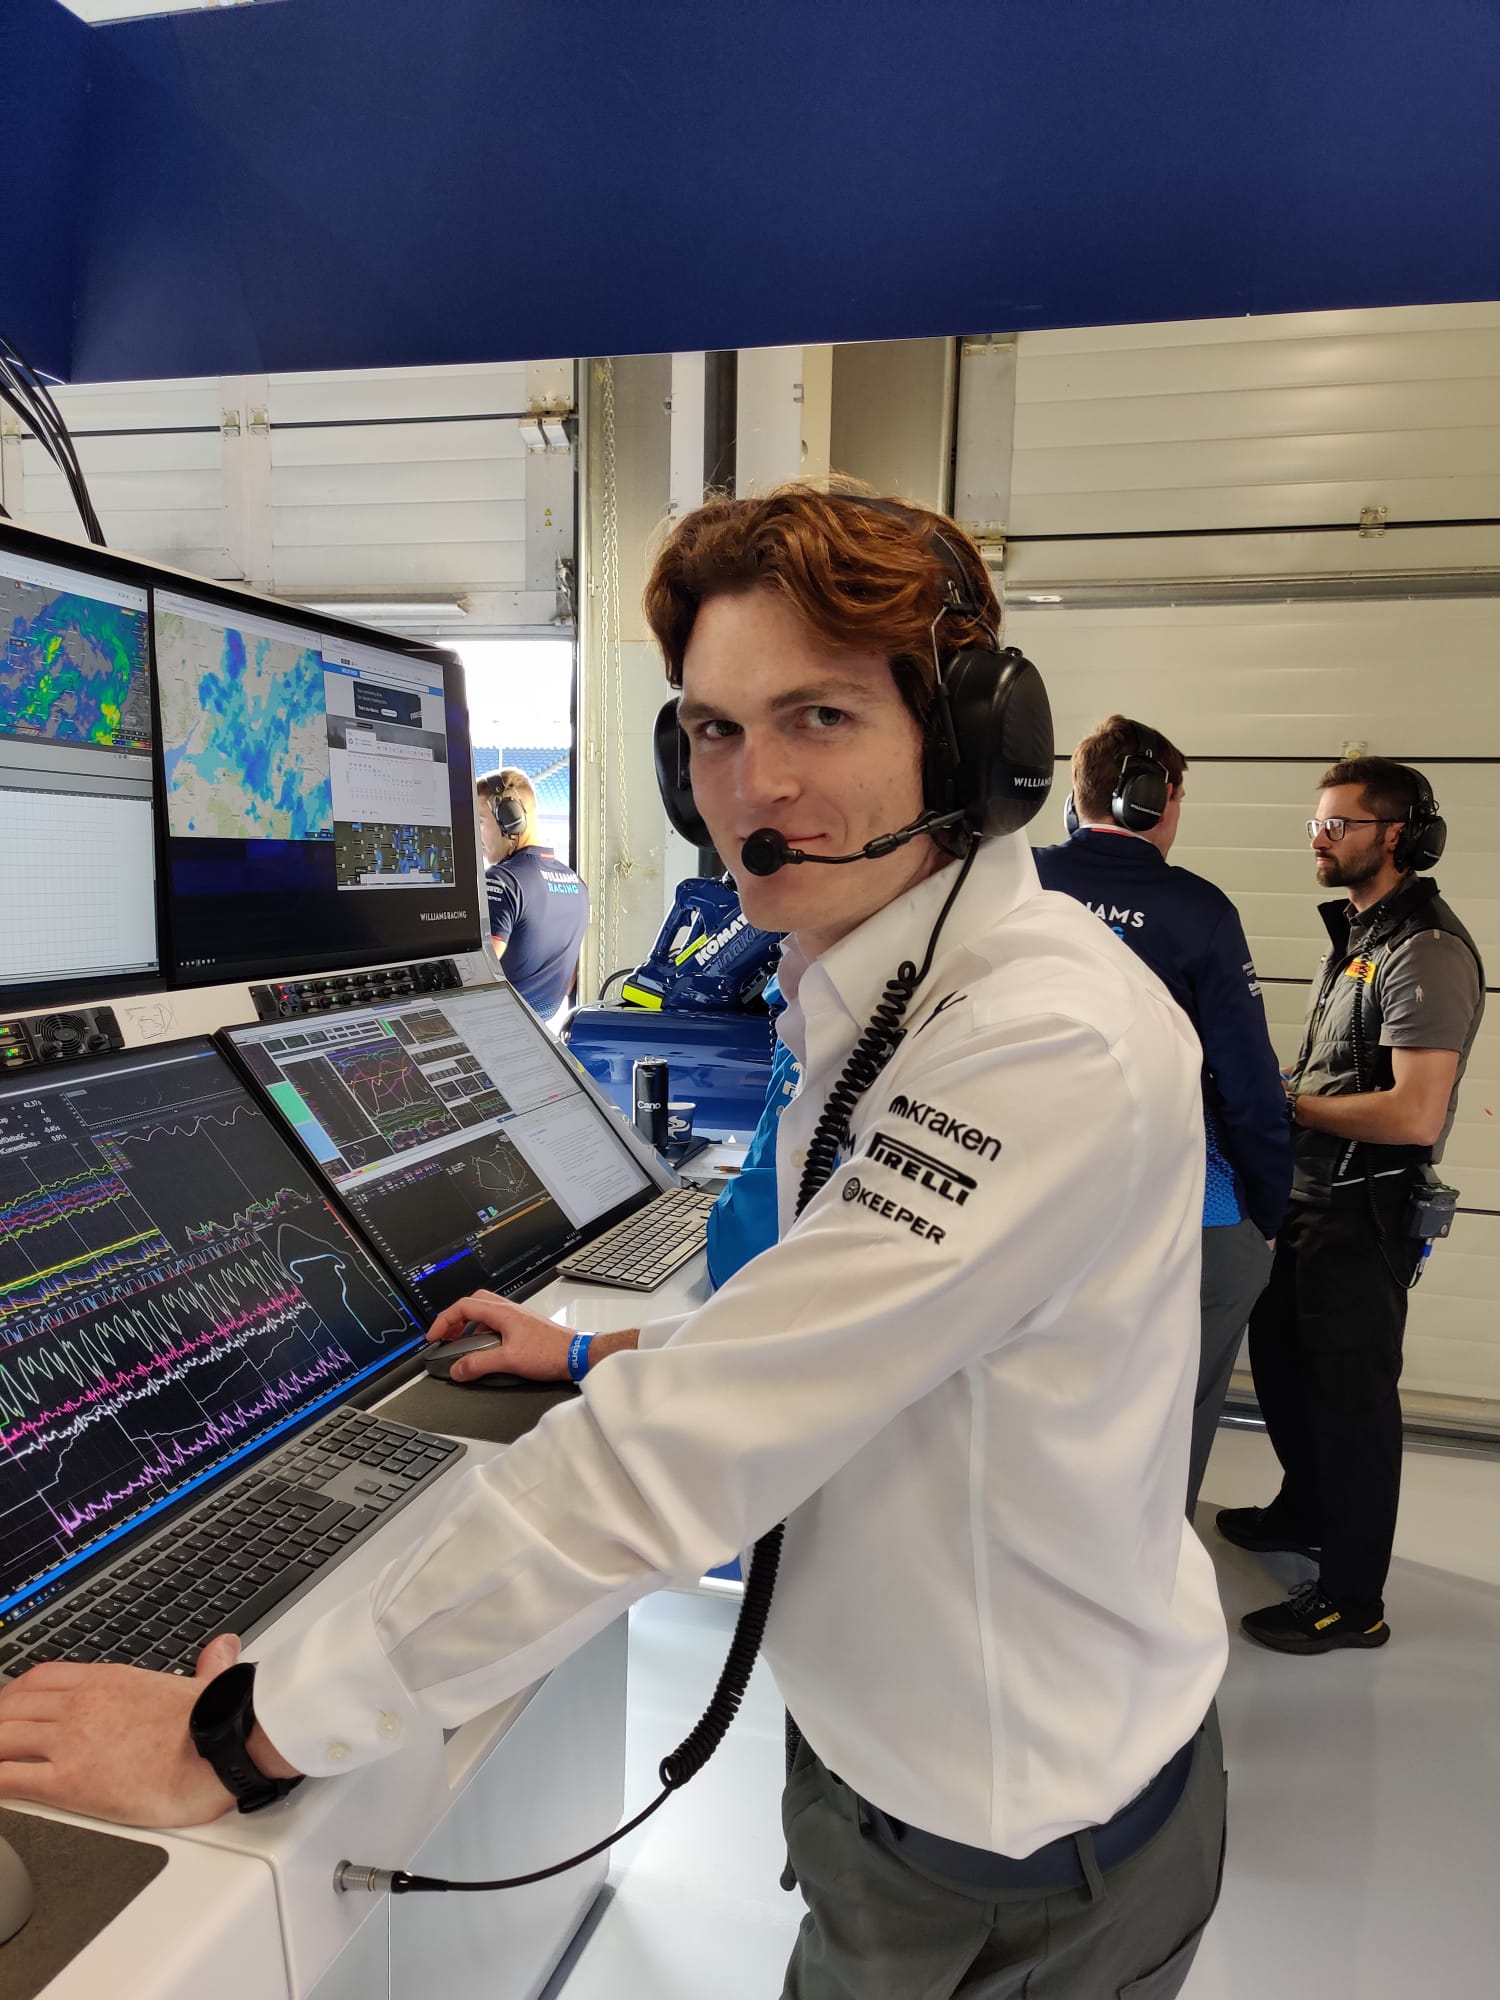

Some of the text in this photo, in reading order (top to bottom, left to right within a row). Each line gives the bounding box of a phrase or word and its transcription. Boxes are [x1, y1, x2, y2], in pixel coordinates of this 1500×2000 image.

[540, 869, 579, 884] WILLIAMS
[547, 883, 579, 895] RACING
[906, 1100, 1002, 1162] kraken
[865, 1132, 978, 1206] PIRELLI
[857, 1188, 946, 1245] KEEPER
